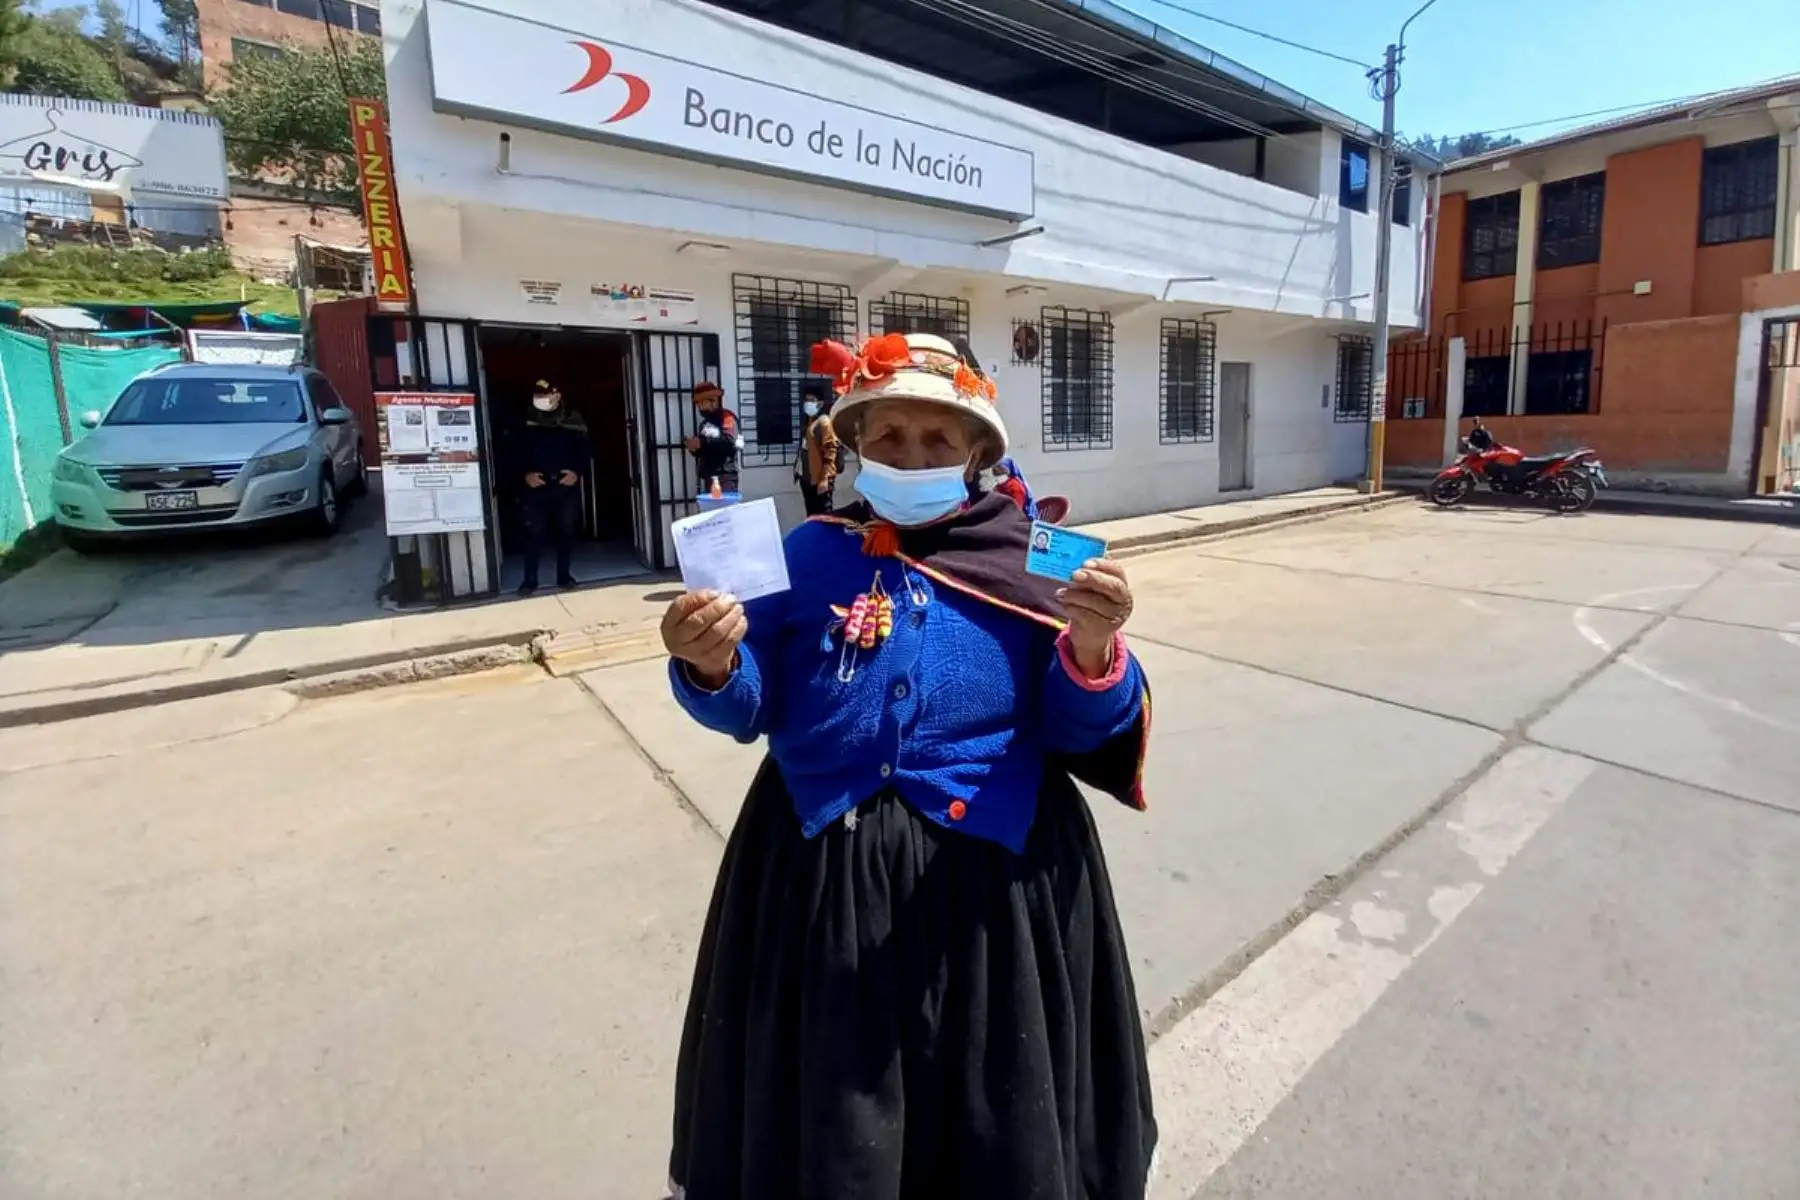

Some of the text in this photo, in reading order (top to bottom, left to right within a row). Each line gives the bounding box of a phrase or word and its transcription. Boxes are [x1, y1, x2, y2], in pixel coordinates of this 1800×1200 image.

[24, 141, 118, 182] Gris
[683, 87, 983, 188] Banco de la Nación
[355, 104, 403, 295] PIZZERIA
